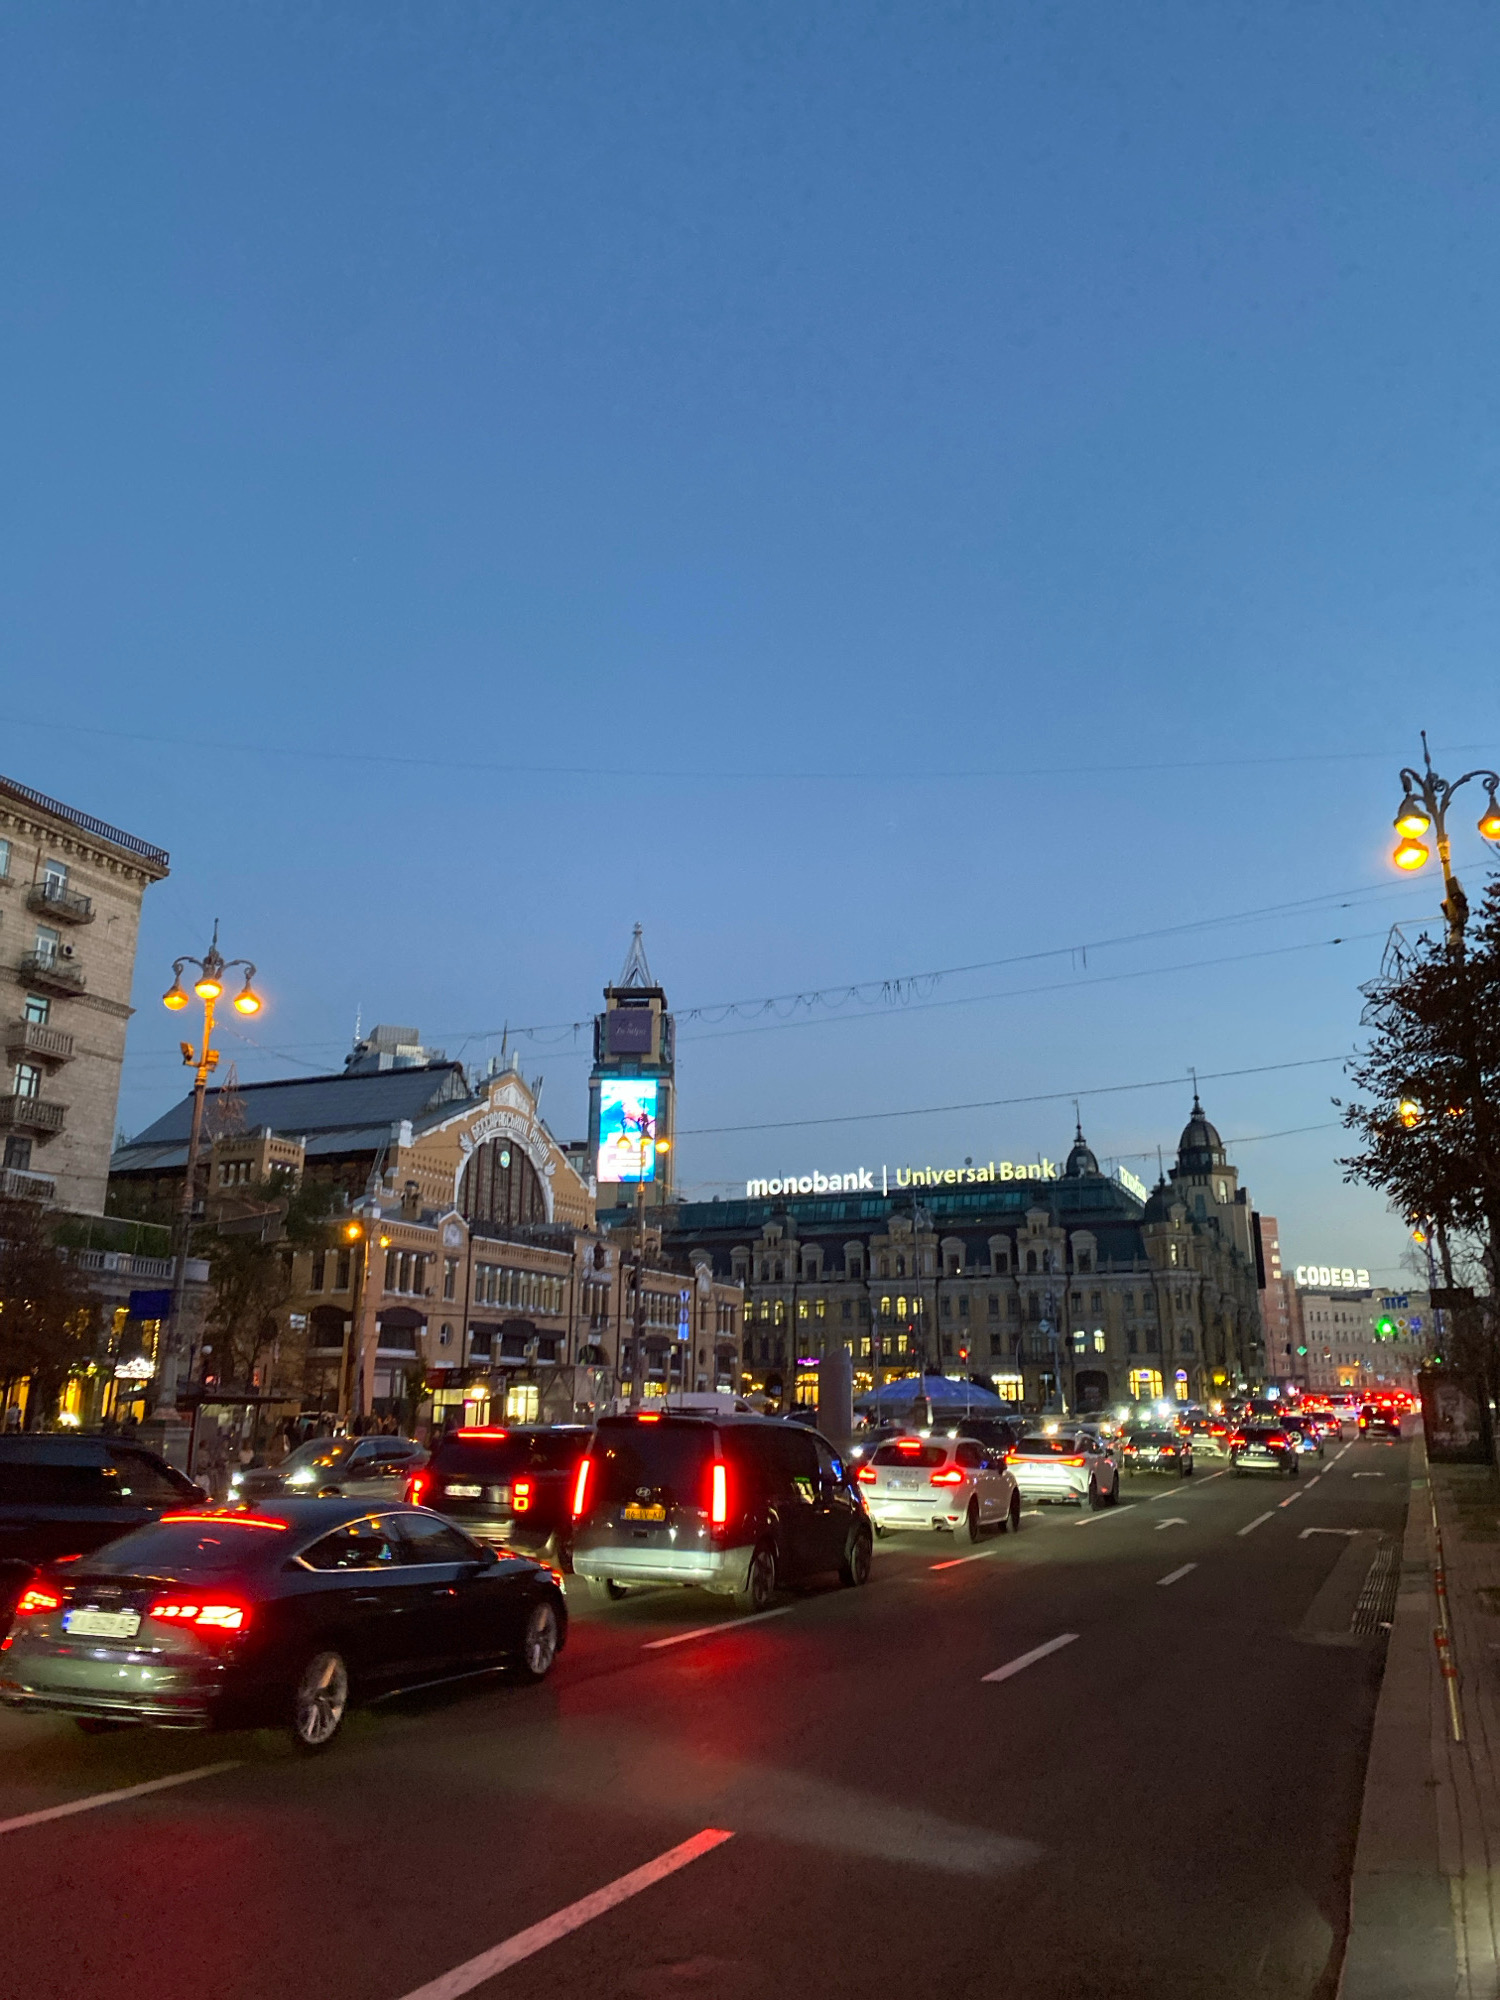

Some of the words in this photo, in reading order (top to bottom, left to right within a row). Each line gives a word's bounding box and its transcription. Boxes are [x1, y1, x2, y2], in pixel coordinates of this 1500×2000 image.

[747, 1167, 873, 1196] monobank
[896, 1162, 995, 1186] Universal
[1000, 1158, 1056, 1180] Bank
[1296, 1266, 1370, 1288] CODE9.2
